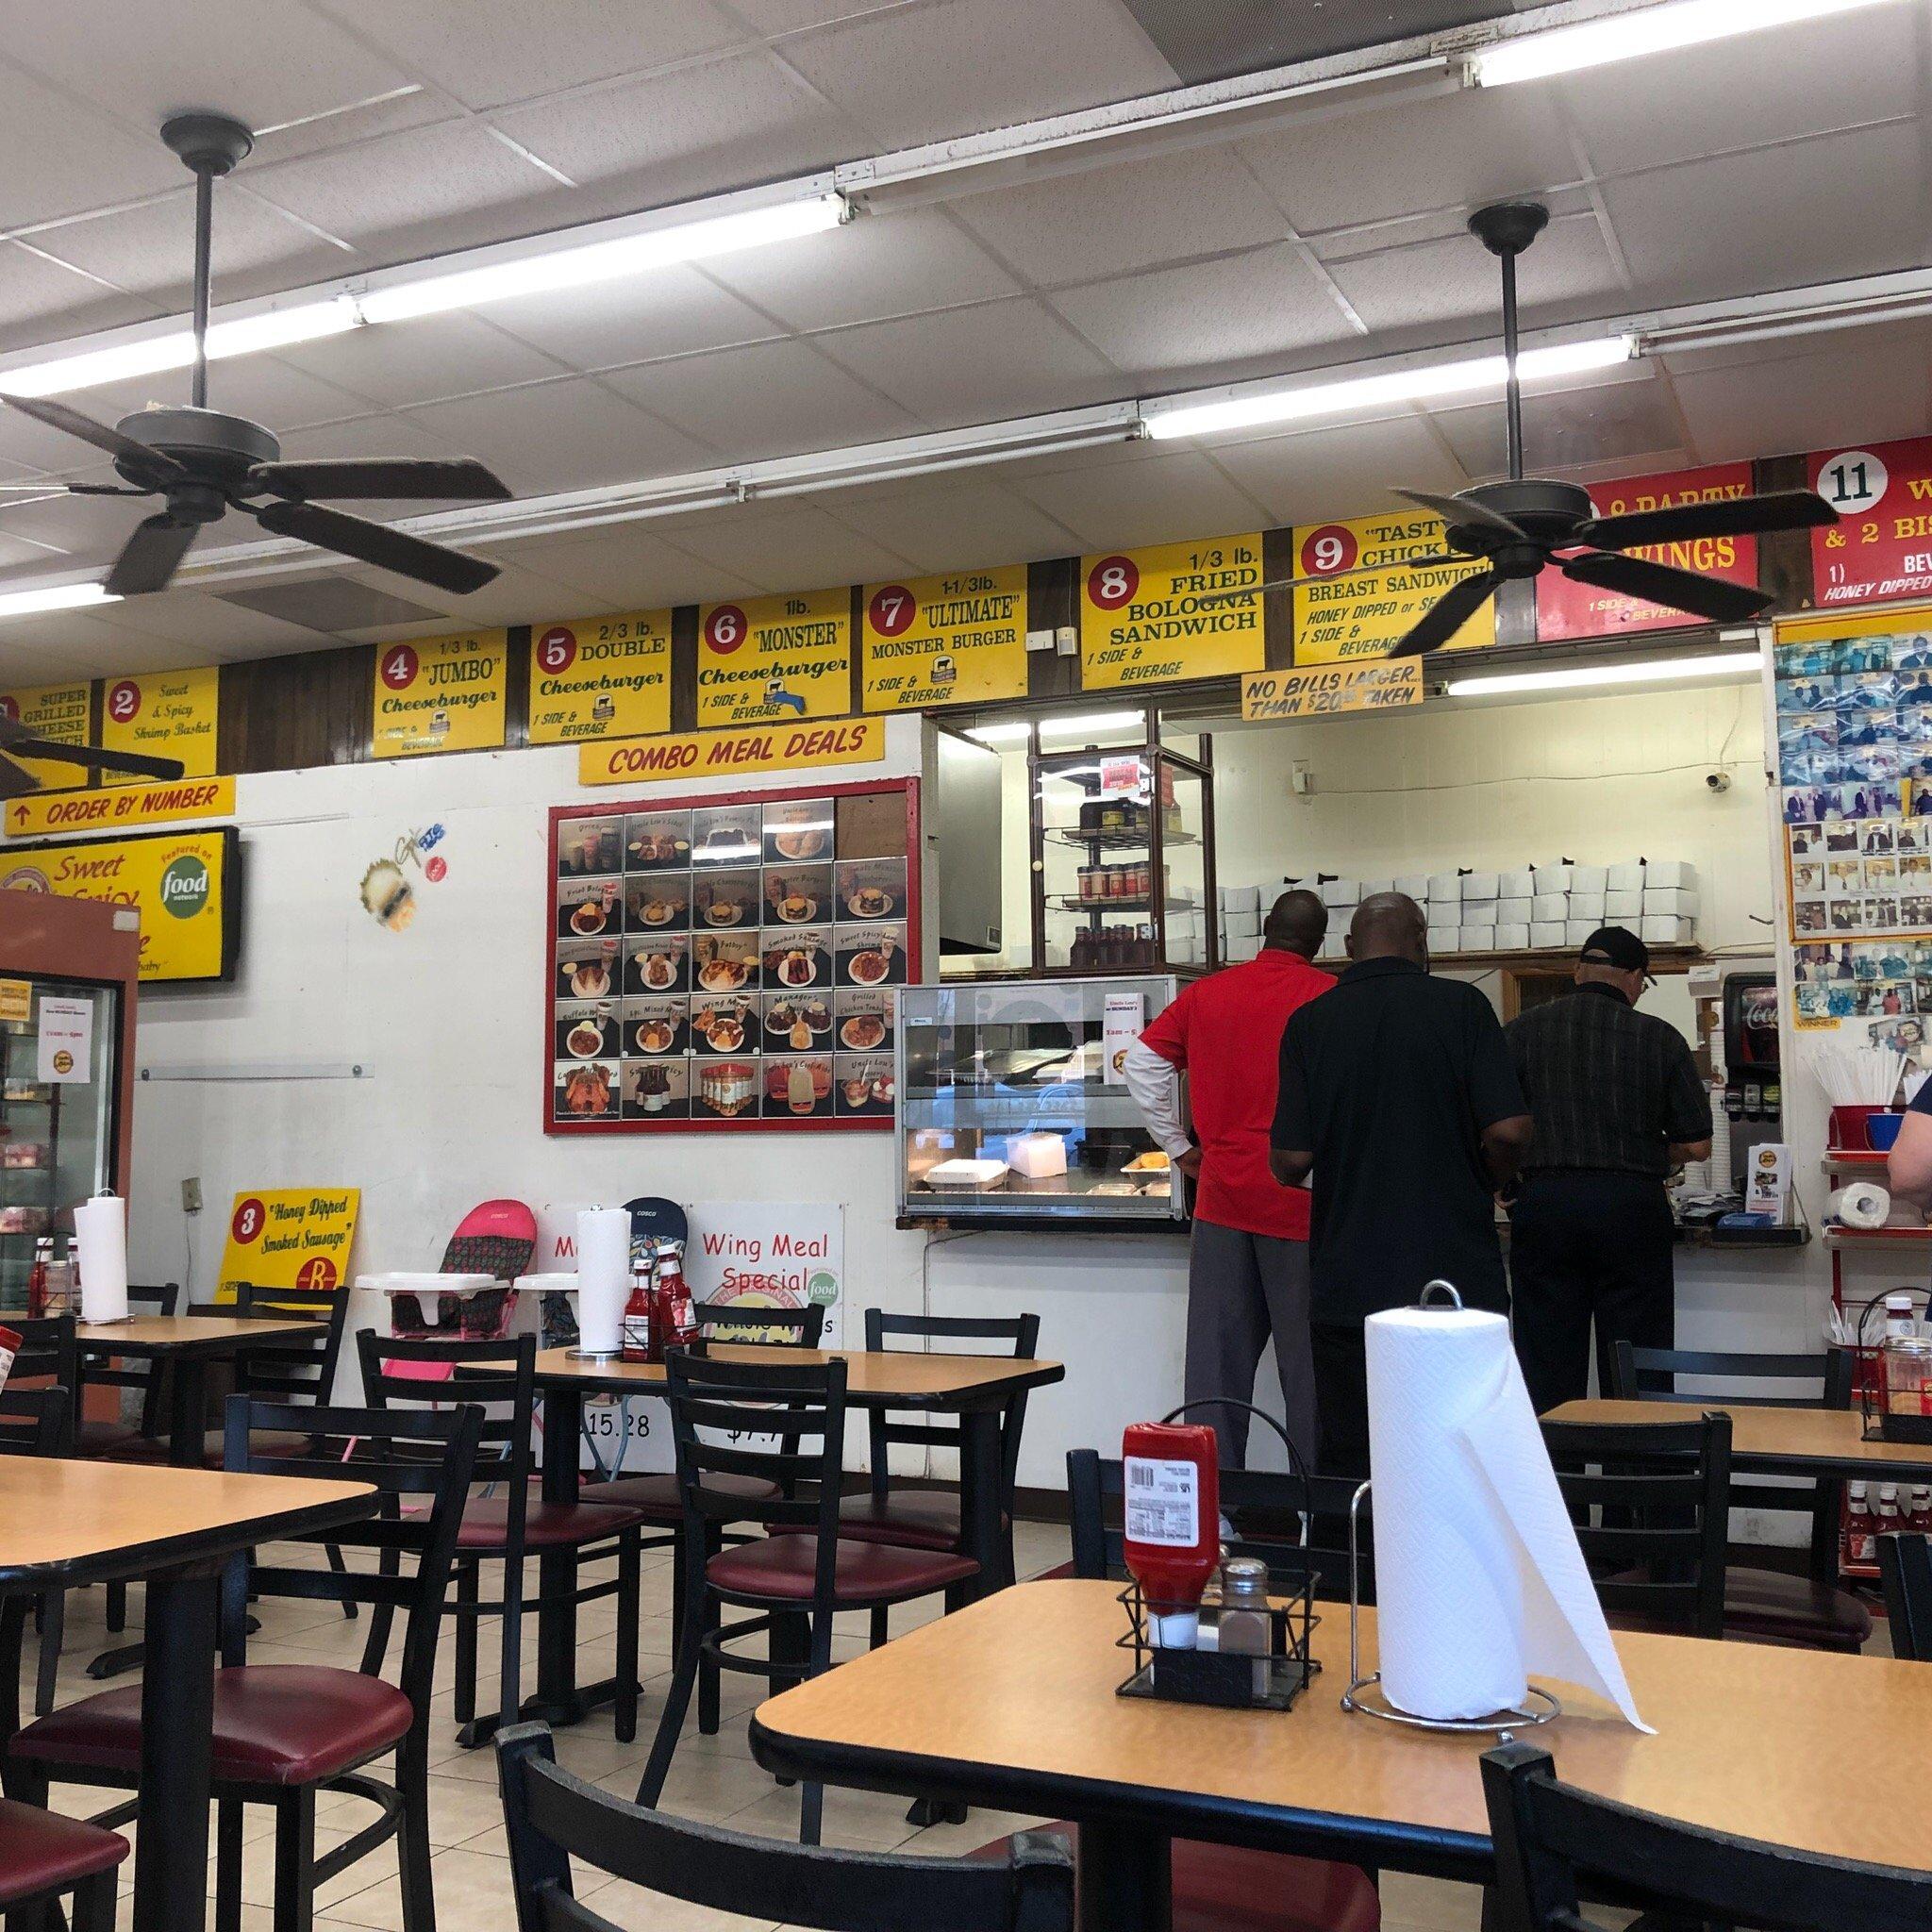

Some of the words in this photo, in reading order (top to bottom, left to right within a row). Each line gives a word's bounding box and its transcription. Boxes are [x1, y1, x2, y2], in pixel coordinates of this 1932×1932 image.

[1831, 462, 1873, 503] 11
[1825, 529, 1846, 548] &
[1861, 523, 1878, 543] 2
[1893, 515, 1932, 539] BI
[1315, 537, 1343, 571] 9
[1101, 567, 1128, 600] 8
[1190, 549, 1224, 572] 1/3
[1170, 568, 1257, 595] FRIED
[1307, 579, 1379, 603] BREAST
[1824, 582, 1876, 601] HONEY
[1877, 575, 1932, 594] DIPPED
[881, 595, 904, 628] 7
[1126, 591, 1257, 623] BOLOGNA
[1307, 607, 1350, 626] HONEY
[1351, 601, 1396, 620] DIPPED
[1400, 602, 1415, 613] or
[1597, 598, 1626, 610] SIDE
[713, 614, 737, 645] 6
[1110, 611, 1257, 646] SANDWICH
[1299, 630, 1307, 645] 1
[1310, 626, 1346, 643] SIDE
[1349, 625, 1361, 639] &
[545, 637, 566, 666] 5
[599, 624, 628, 641] 2/3
[580, 638, 666, 661] DOUBLE
[871, 637, 944, 660] MONSTER
[951, 628, 1016, 650] BURGER
[1087, 653, 1094, 666] 1
[1097, 648, 1129, 665] SIDE
[1131, 647, 1142, 660] &
[387, 653, 409, 680] 4
[440, 640, 461, 656] 1/3
[698, 658, 849, 686] Cheeseburger
[1120, 661, 1184, 681] BEVERAGE
[540, 672, 664, 696] Cheeseburger
[866, 680, 874, 692] 1
[876, 676, 905, 691] SIDE
[907, 675, 918, 689] &
[897, 687, 955, 705] BEVERAGE
[1246, 680, 1276, 699] NO
[1284, 673, 1341, 697] BILLS
[41, 690, 87, 707] SUPER
[115, 689, 134, 716] 2
[381, 691, 498, 714] Cheeseburger
[702, 696, 709, 708] 1
[710, 693, 738, 708] SIDE
[740, 692, 750, 705] &
[731, 703, 782, 720] BEVERAGE
[1250, 697, 1303, 719] THAN
[24, 705, 86, 724] GRILLED
[533, 714, 540, 725] 1
[541, 711, 567, 725] SIDE
[568, 711, 577, 723] &
[560, 722, 608, 737] BEVERAGE
[608, 742, 699, 775] COMBO
[707, 736, 773, 766] MEAL
[784, 724, 867, 758] DEALS
[46, 799, 109, 825] ORDER
[114, 795, 139, 818] BY
[141, 784, 219, 813] NUMBER
[54, 854, 127, 882] Sweet
[162, 869, 208, 903] food
[1797, 1019, 1838, 1028] WINNER
[242, 1208, 257, 1235] 3
[308, 1196, 348, 1222] Dipped
[261, 1231, 300, 1255] Smoked
[703, 1233, 761, 1263] Wing
[772, 1234, 828, 1257] Meal
[722, 1267, 808, 1296] Special
[808, 1281, 837, 1298] food
